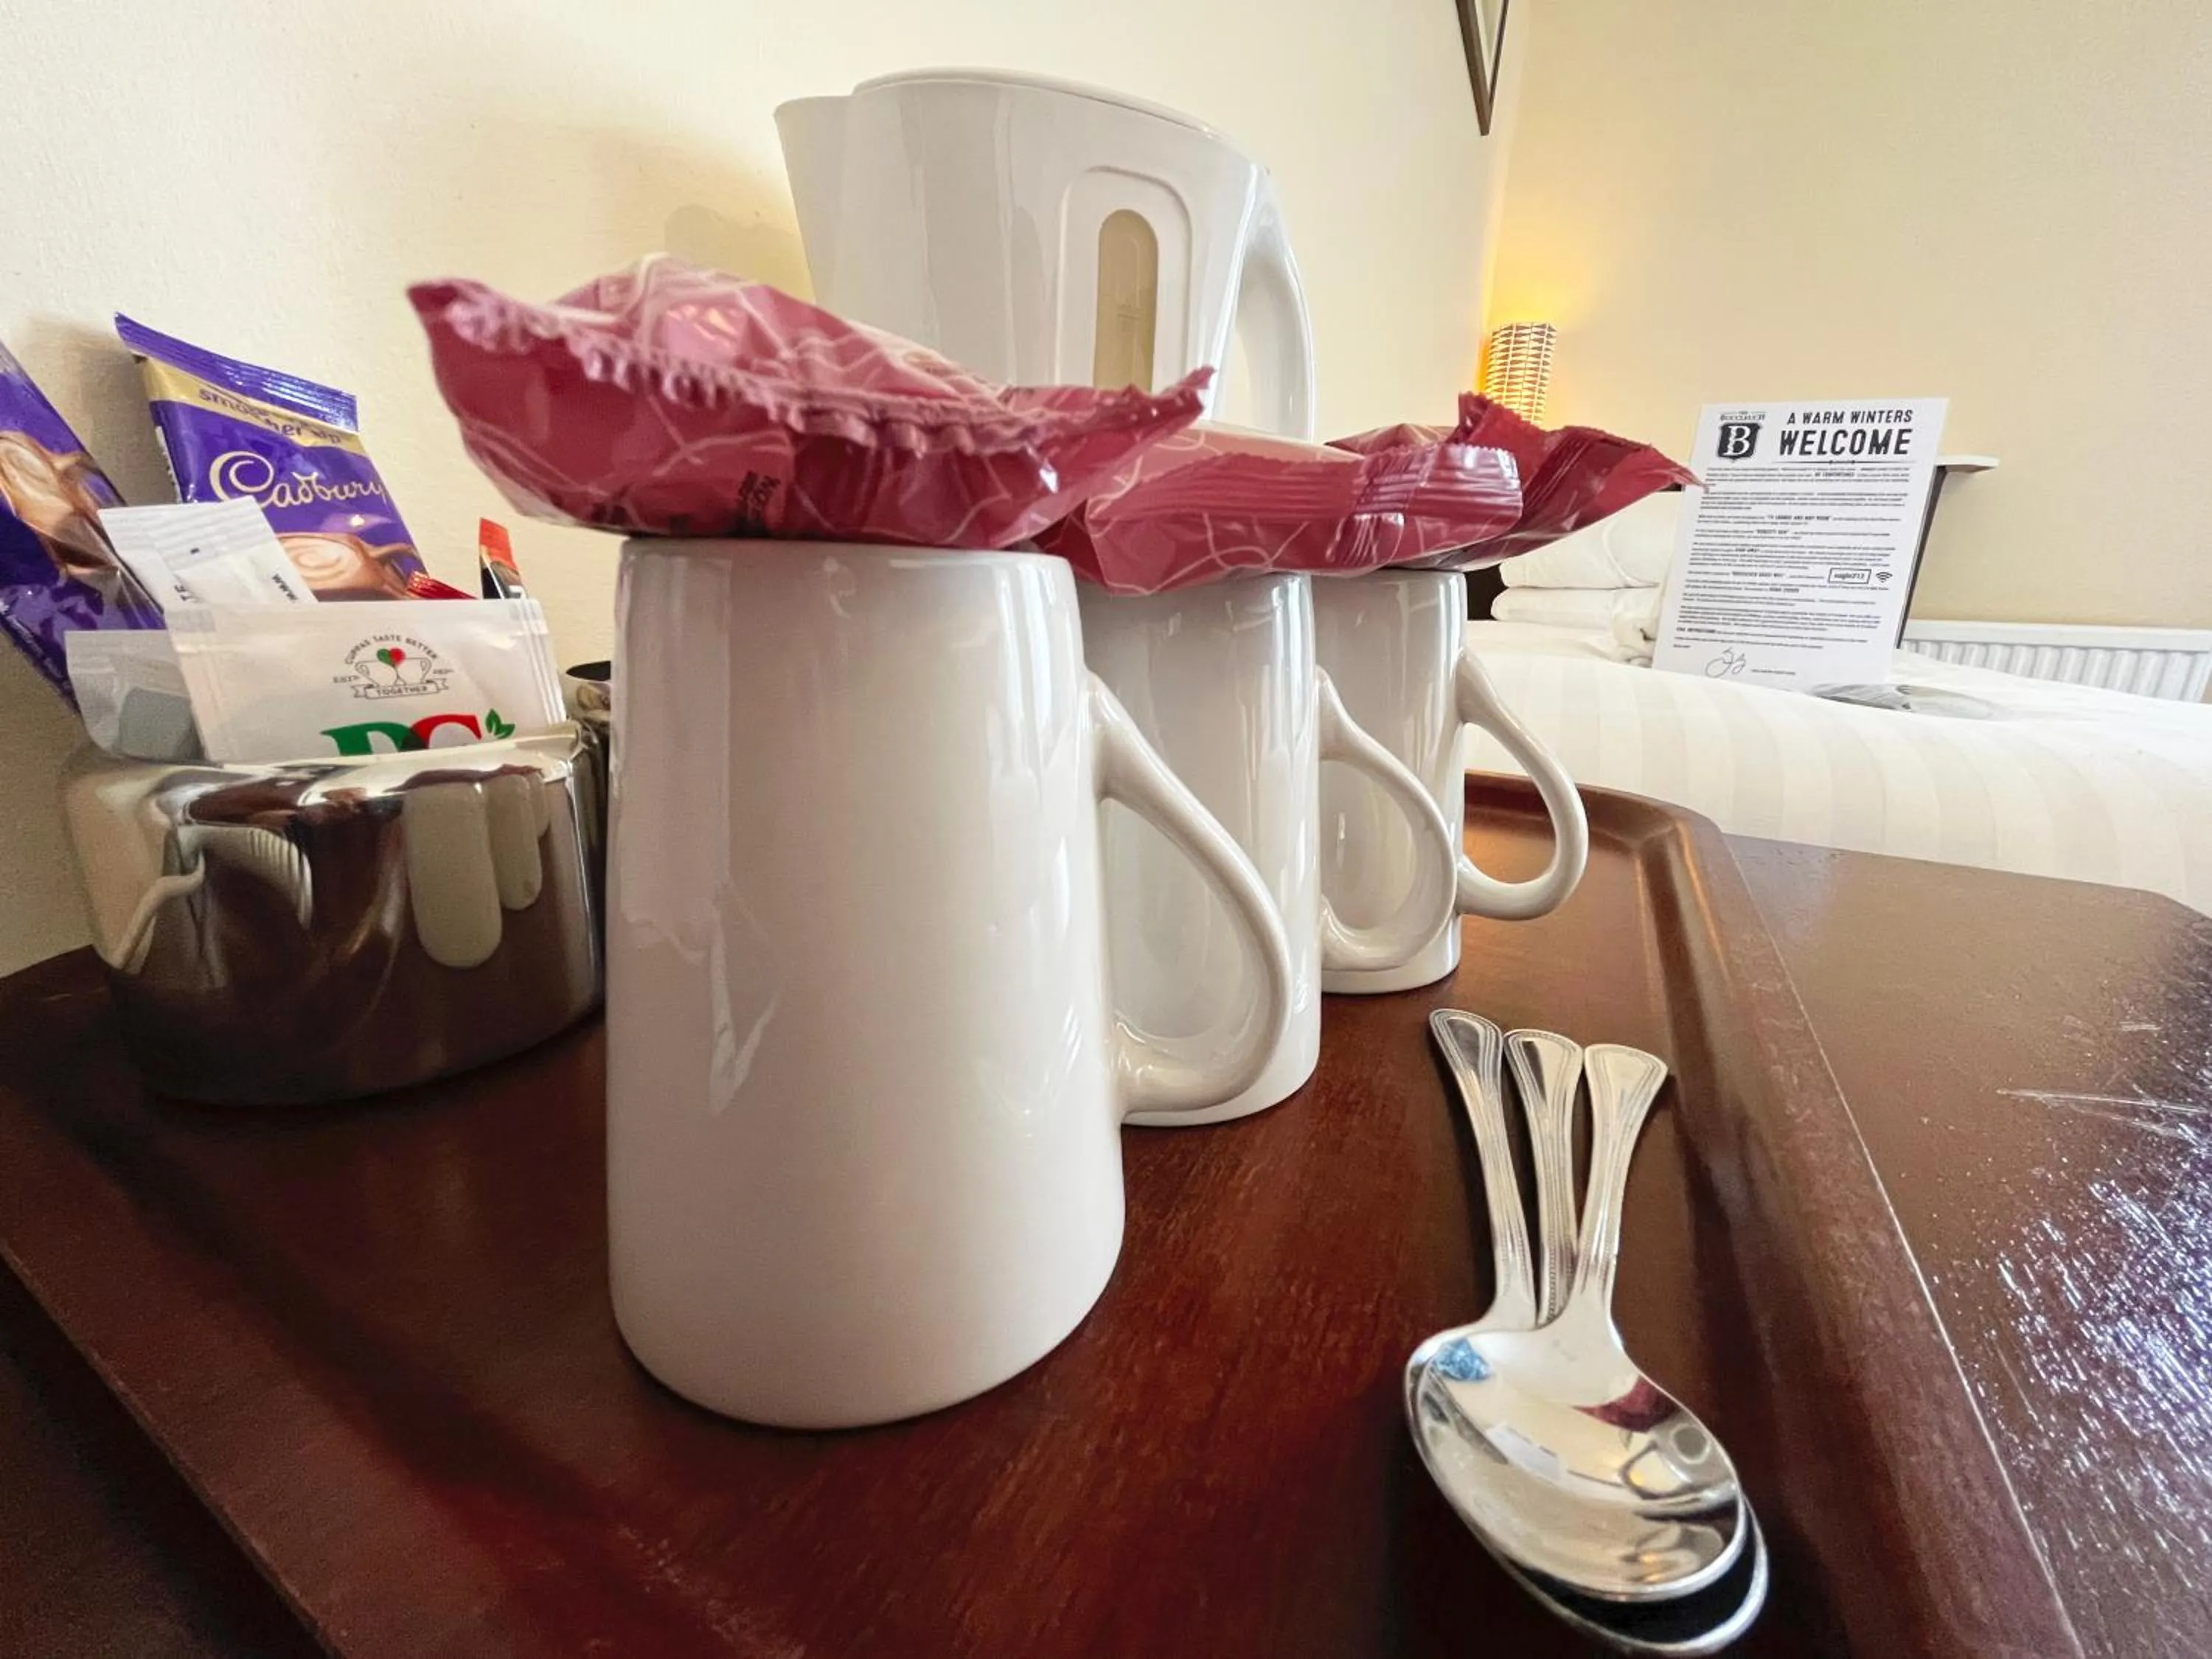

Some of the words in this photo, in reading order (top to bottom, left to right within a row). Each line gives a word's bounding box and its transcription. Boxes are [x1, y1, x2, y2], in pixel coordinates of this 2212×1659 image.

[1787, 412, 1796, 425] A
[1802, 411, 1844, 425] WARM
[1850, 409, 1914, 425] WINTERS
[1778, 428, 1913, 456] WELCOME
[209, 451, 387, 509] Cadbury
[372, 634, 401, 643] TASTE
